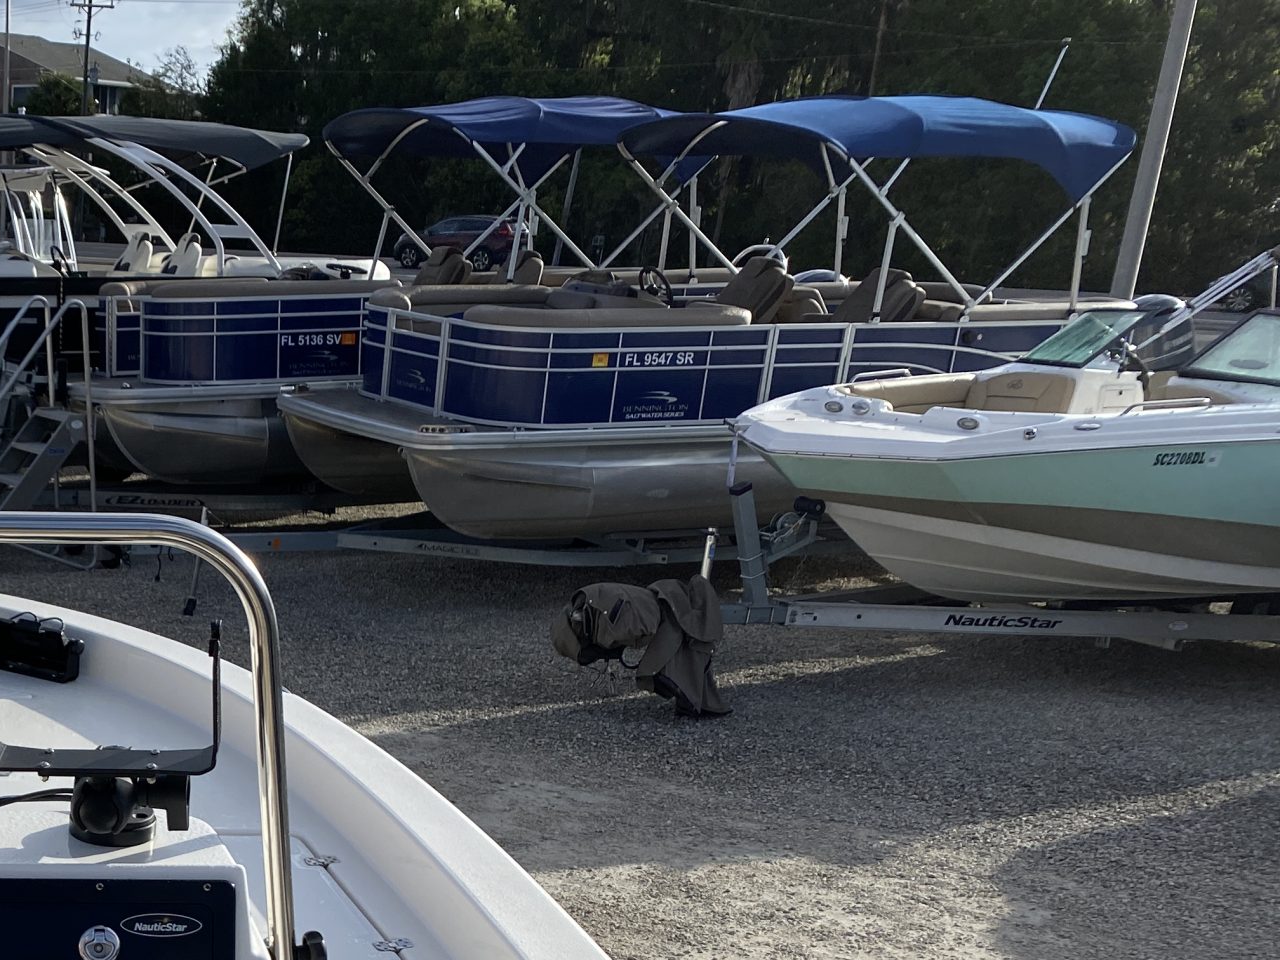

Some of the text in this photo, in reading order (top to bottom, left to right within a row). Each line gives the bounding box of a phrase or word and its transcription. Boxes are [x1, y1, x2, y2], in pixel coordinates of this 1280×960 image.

[281, 334, 342, 346] FL 5136 SV
[625, 352, 694, 366] FL 9547 SR
[1153, 452, 1206, 466] SC2708DL
[944, 614, 1063, 629] NauticStar
[133, 922, 188, 932] NauticStar
